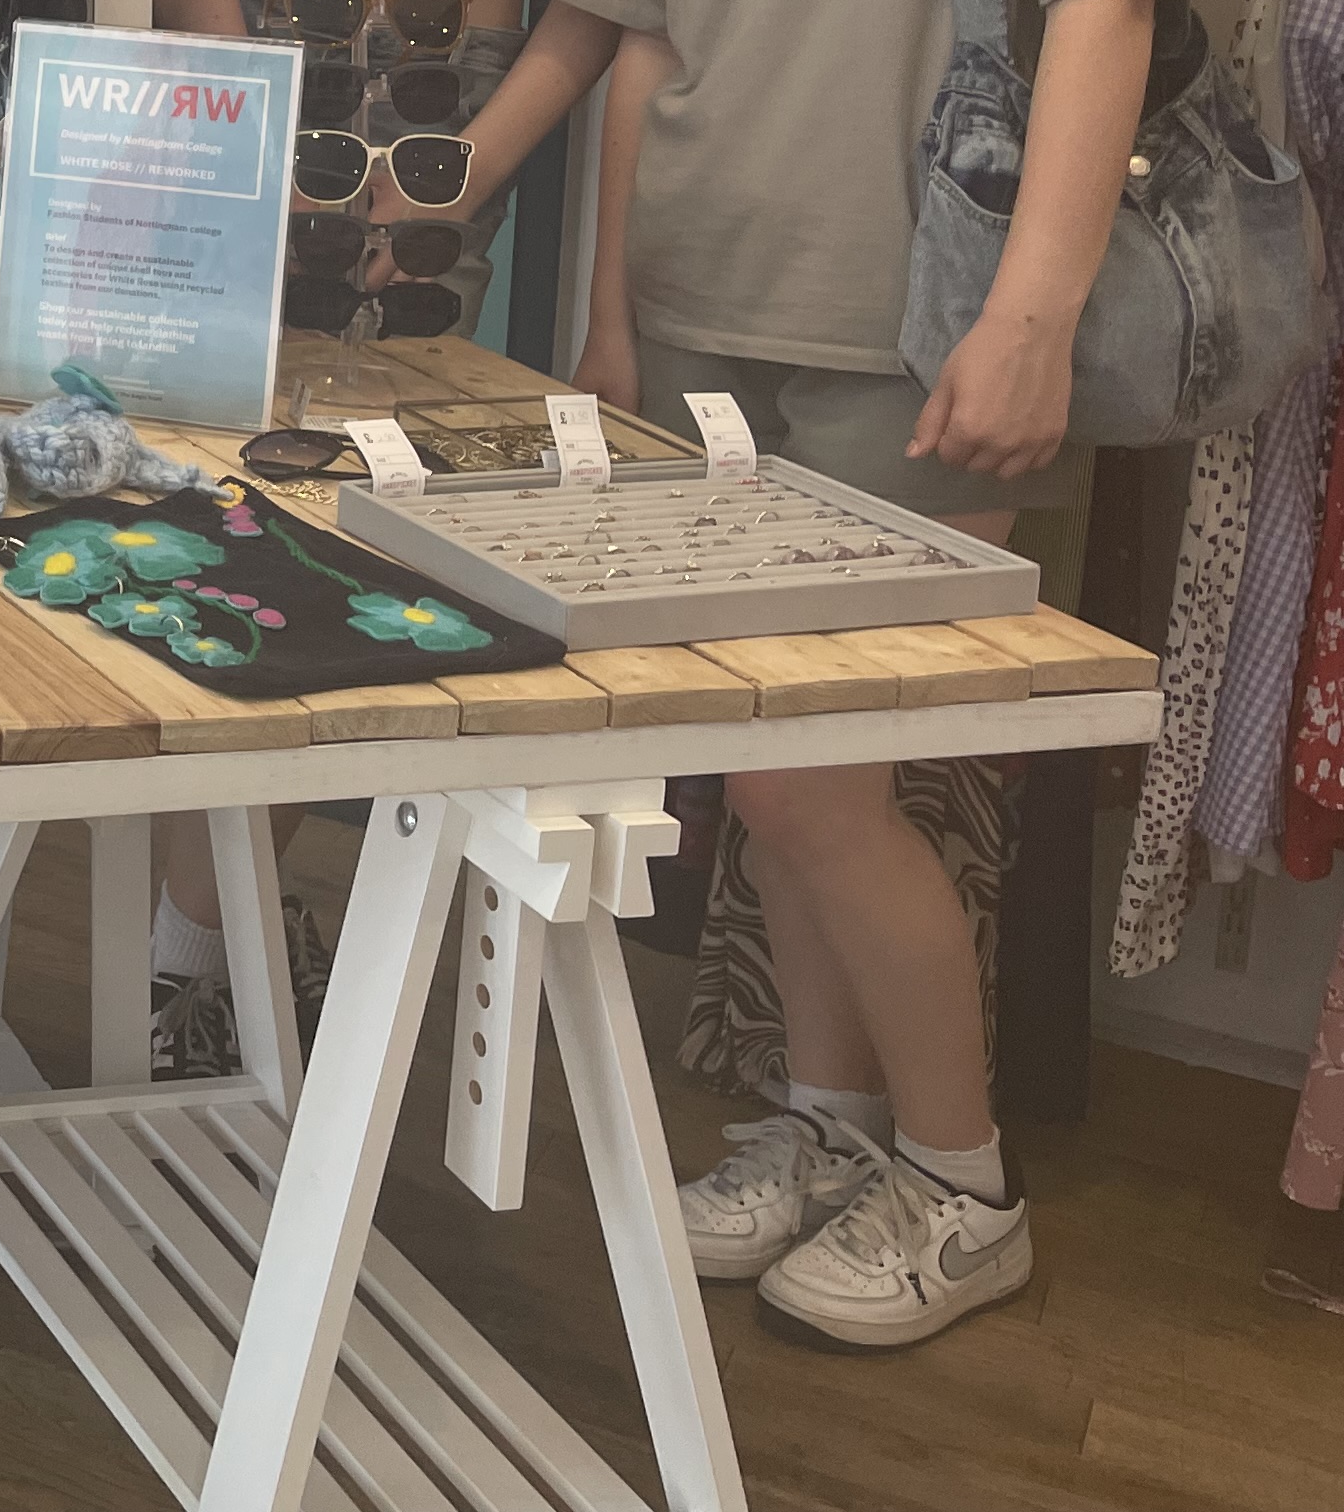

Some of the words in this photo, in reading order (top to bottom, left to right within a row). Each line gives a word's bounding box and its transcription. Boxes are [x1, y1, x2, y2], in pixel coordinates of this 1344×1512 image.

[60, 129, 108, 143] Designed
[109, 134, 121, 145] by
[123, 134, 184, 151] Nottingham
[185, 141, 224, 155] College
[60, 155, 100, 169] WHITE
[101, 159, 132, 173] ROSE
[148, 165, 216, 181] REWORKED
[47, 209, 82, 222] Fashion
[83, 213, 123, 226] Students
[125, 218, 134, 226] of
[135, 218, 188, 233] Nottingham
[189, 225, 222, 237] college
[44, 243, 55, 253] To
[57, 246, 85, 257] design
[87, 250, 104, 258] and
[105, 252, 134, 262] create
[143, 256, 195, 268] sustainable
[42, 267, 93, 280] accessories
[94, 272, 106, 281] for
[108, 273, 135, 285] White
[137, 277, 159, 287] Rose
[186, 284, 225, 295] recycled
[87, 259, 97, 269] of
[174, 271, 192, 280] and
[75, 281, 97, 292] from
[114, 287, 161, 299] donations.
[38, 315, 66, 329] today
[68, 320, 89, 329] and
[90, 321, 113, 334] help
[39, 300, 65, 314] Shop
[86, 307, 146, 323] sustainable
[148, 313, 199, 329] collection
[70, 331, 94, 344] from
